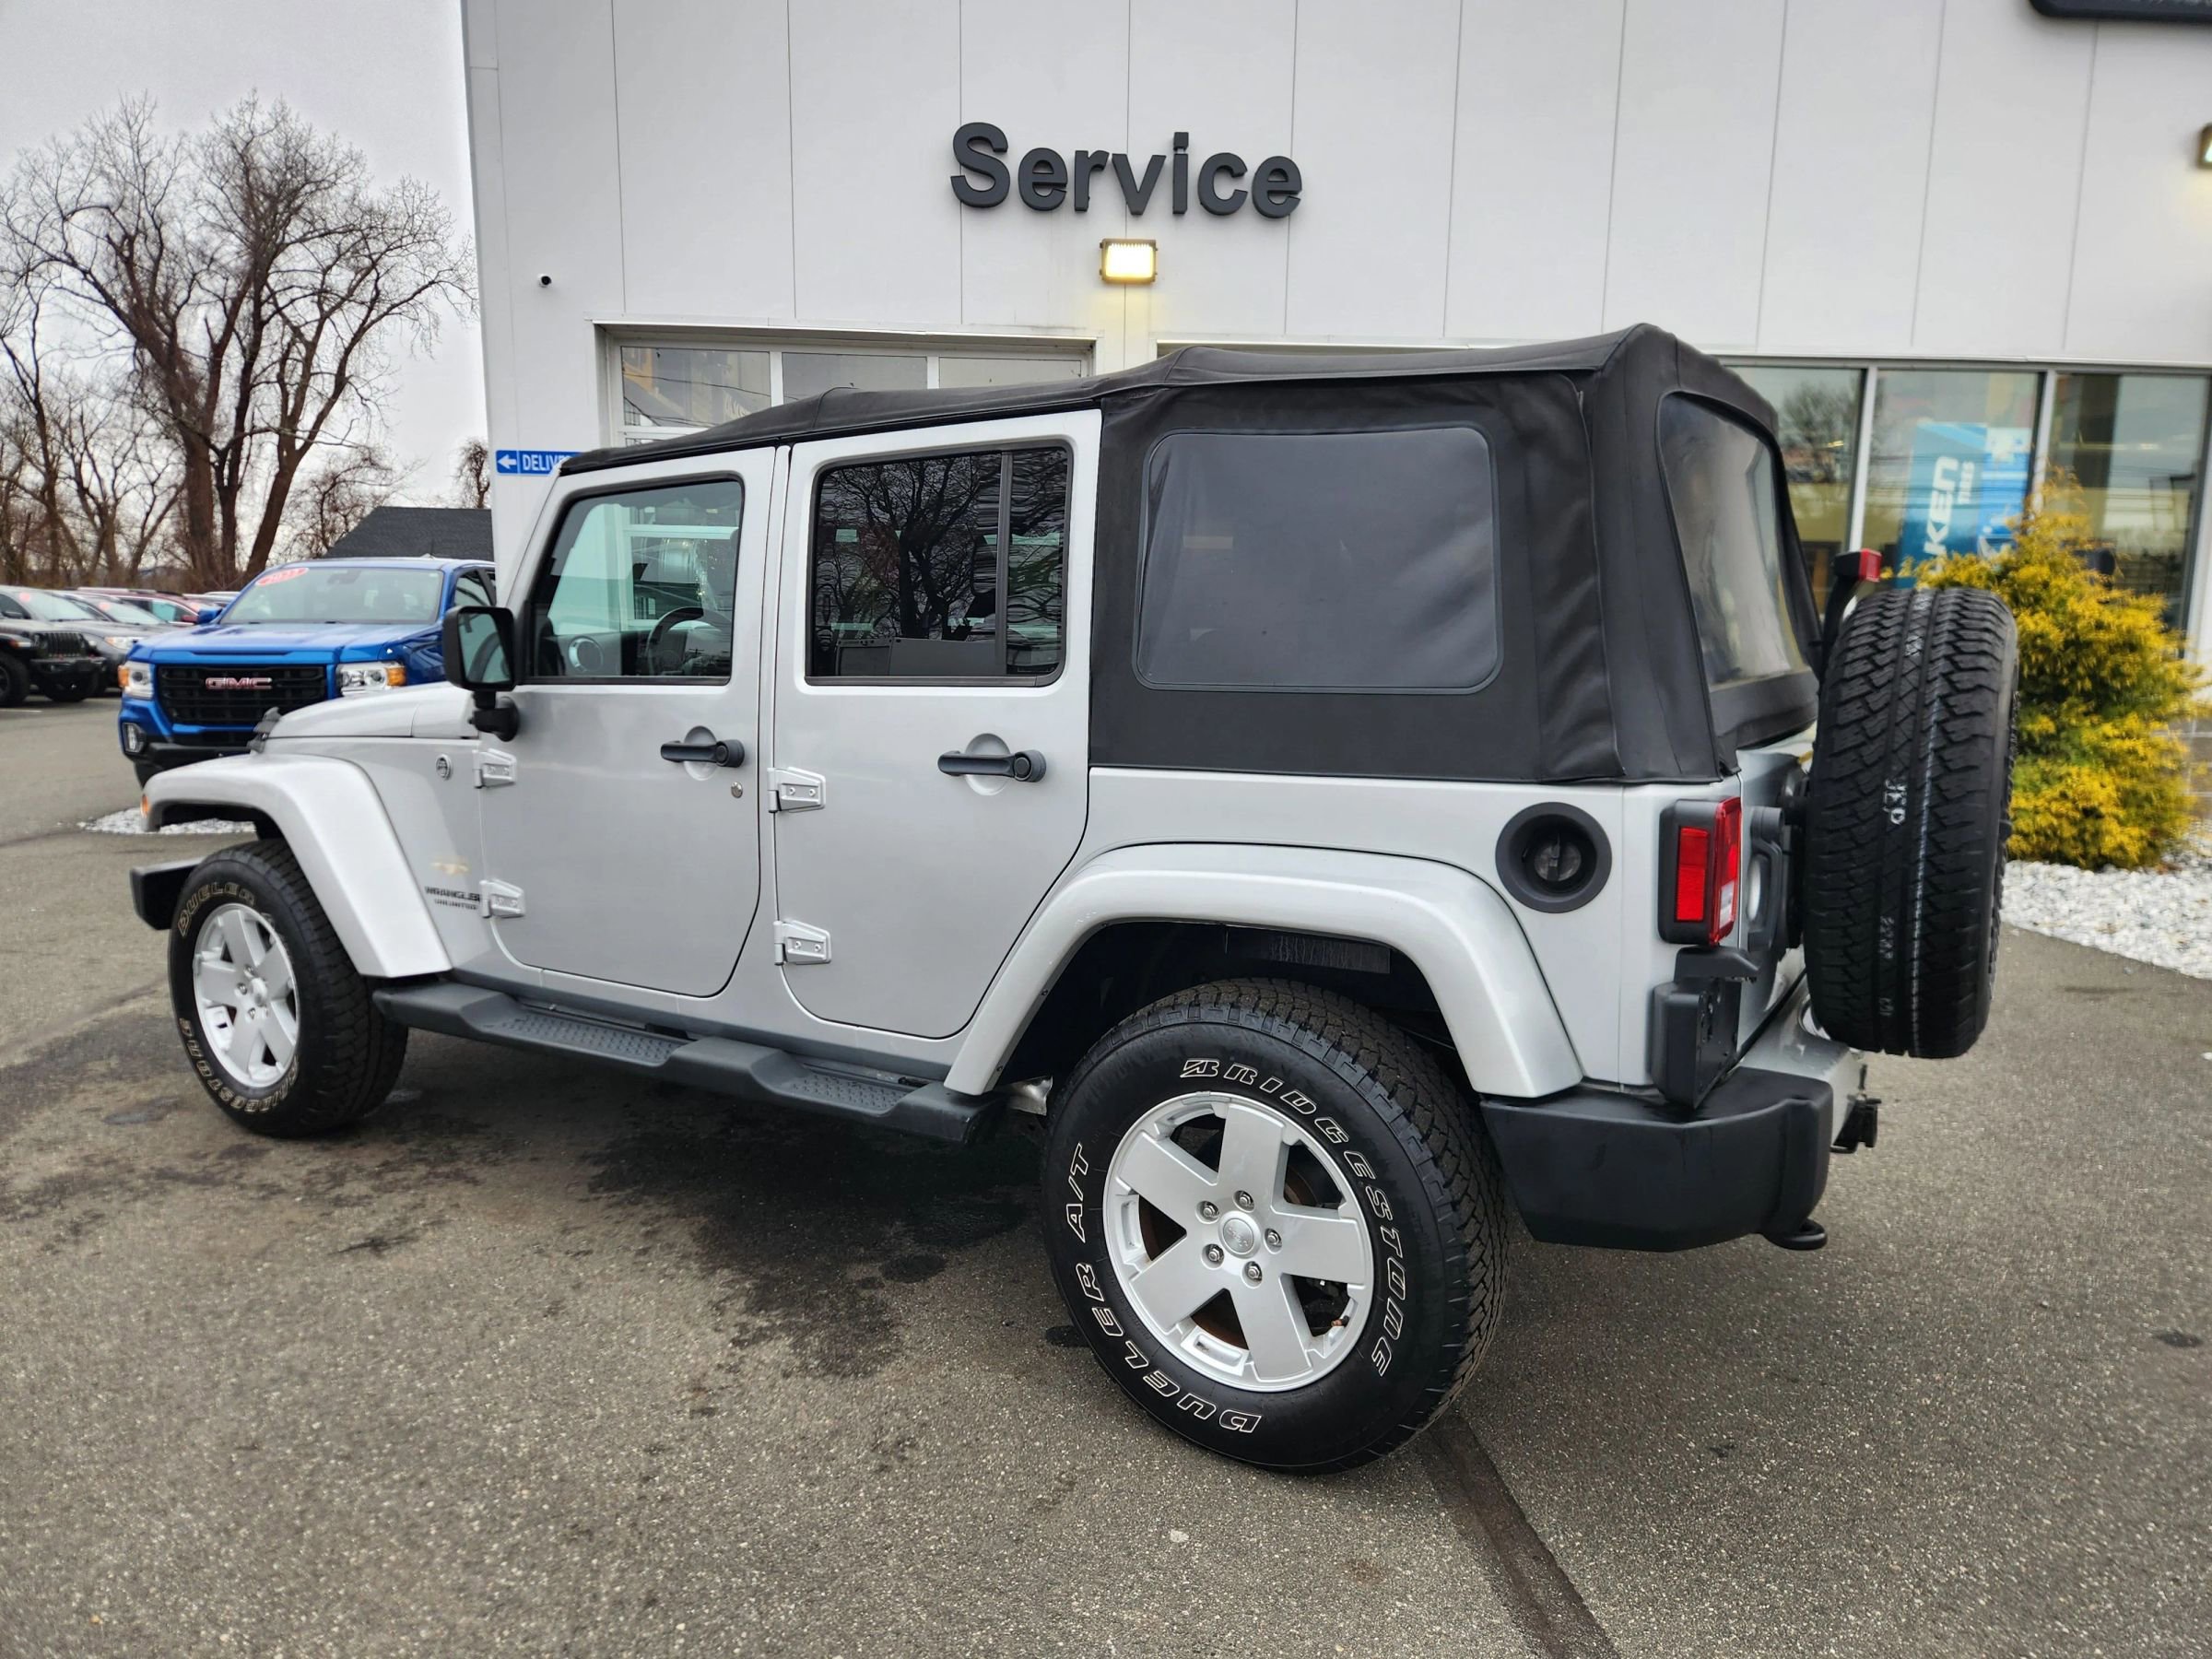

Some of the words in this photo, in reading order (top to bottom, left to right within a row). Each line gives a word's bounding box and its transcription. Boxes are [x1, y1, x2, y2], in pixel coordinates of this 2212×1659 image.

[950, 122, 1302, 218] Service
[522, 453, 571, 471] DELIV
[1924, 455, 1959, 557] KEN
[205, 677, 273, 690] GMC
[177, 881, 257, 937] DUELER
[179, 1017, 300, 1113] BRIDGESTONE
[1065, 1142, 1092, 1244] A/T
[1179, 1058, 1407, 1378] BRIDGESTONE
[1076, 1261, 1263, 1434] DUELER
